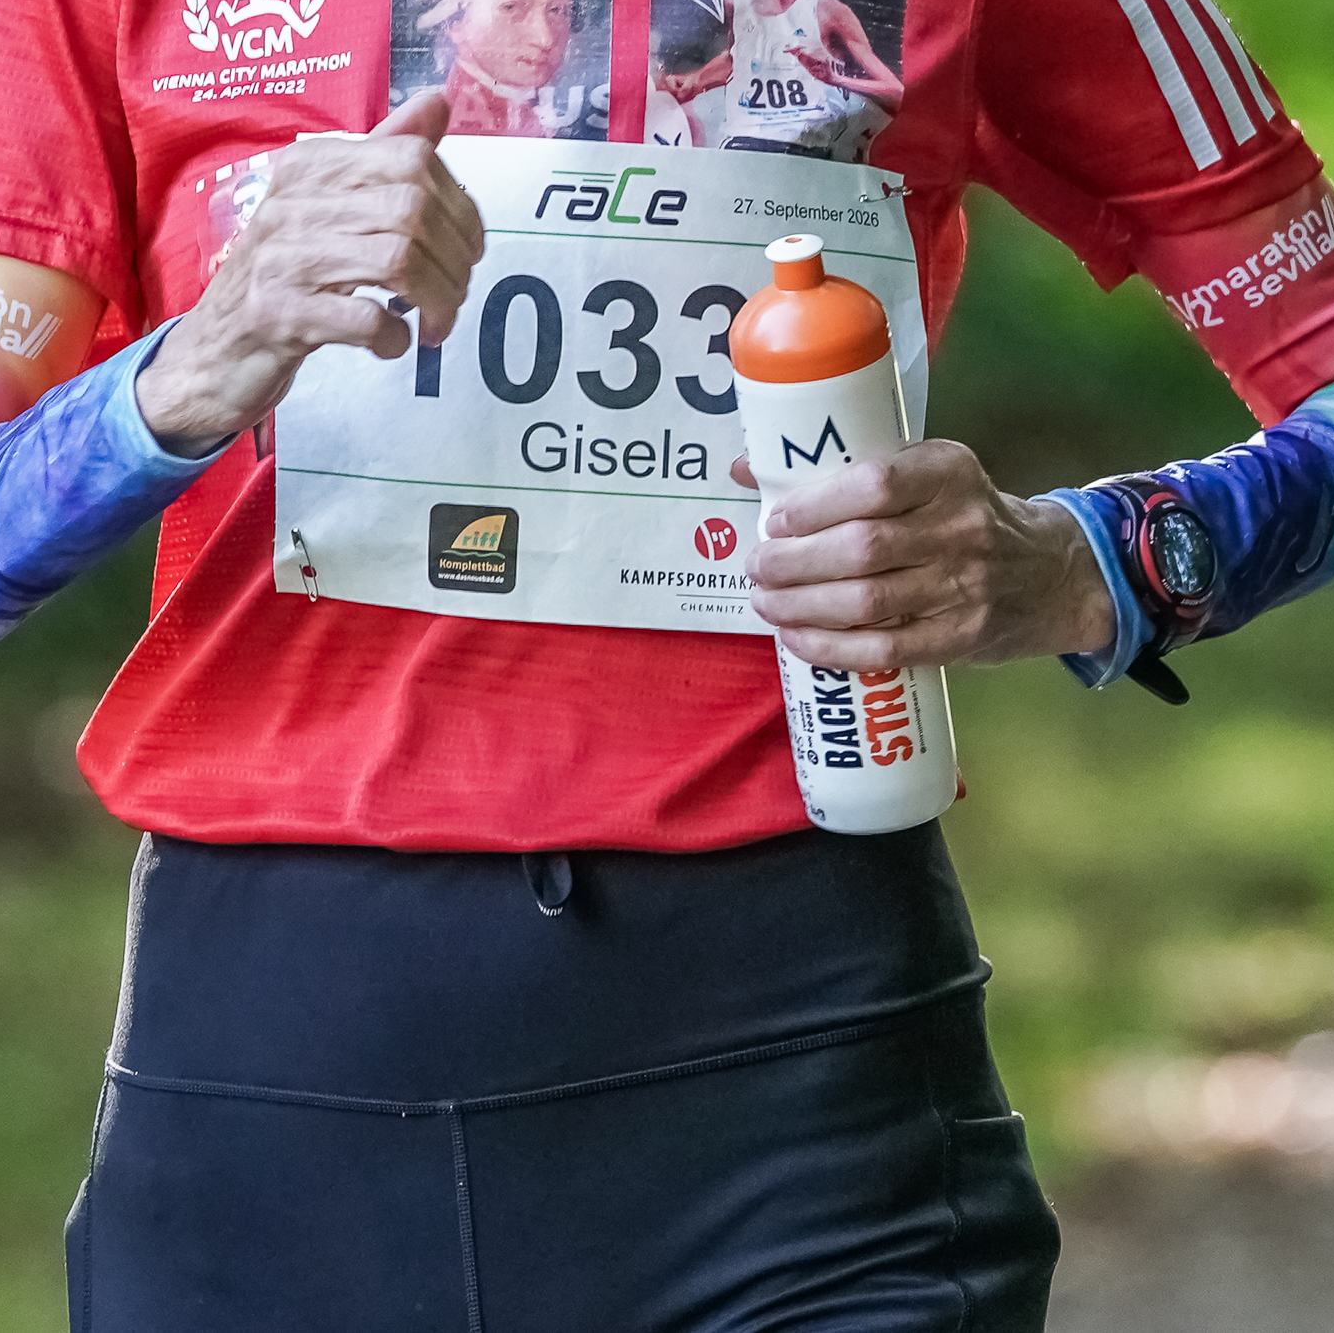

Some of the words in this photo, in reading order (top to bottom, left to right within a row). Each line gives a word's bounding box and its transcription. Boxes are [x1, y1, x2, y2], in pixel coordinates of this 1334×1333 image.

[221, 25, 294, 61] VCM
[152, 72, 216, 92] VIENNA
[219, 66, 258, 84] CITY
[260, 51, 352, 79] MARATHON
[191, 88, 218, 102] 24.
[220, 83, 260, 99] April
[263, 79, 306, 95] 2022
[749, 78, 808, 109] 208
[733, 199, 759, 215] 27.
[764, 200, 843, 223] September
[847, 210, 879, 228] 2026
[1191, 208, 1323, 308] maratón
[520, 421, 708, 480] Gisela
[439, 558, 505, 573] Komplettbad
[680, 602, 744, 615] CHEMNITZ
